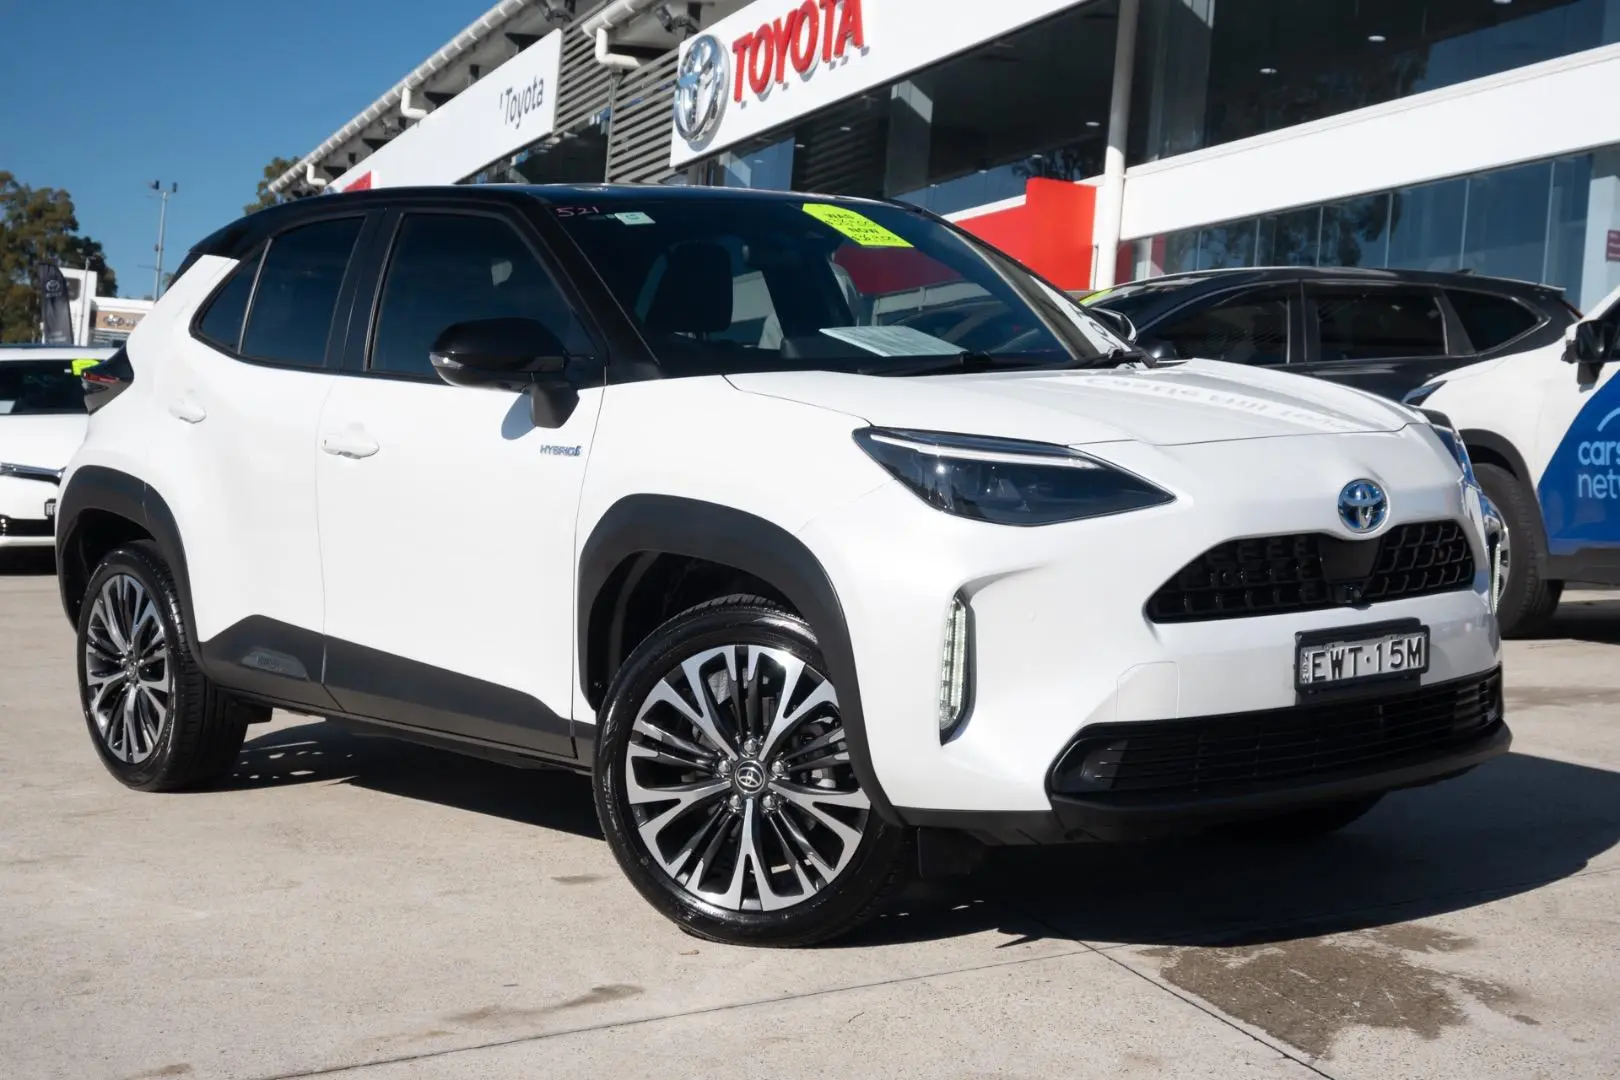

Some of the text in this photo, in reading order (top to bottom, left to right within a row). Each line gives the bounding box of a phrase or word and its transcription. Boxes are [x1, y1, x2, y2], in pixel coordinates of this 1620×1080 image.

[732, 0, 865, 103] TOYOTA
[504, 76, 544, 130] Toyota
[1578, 468, 1620, 499] net
